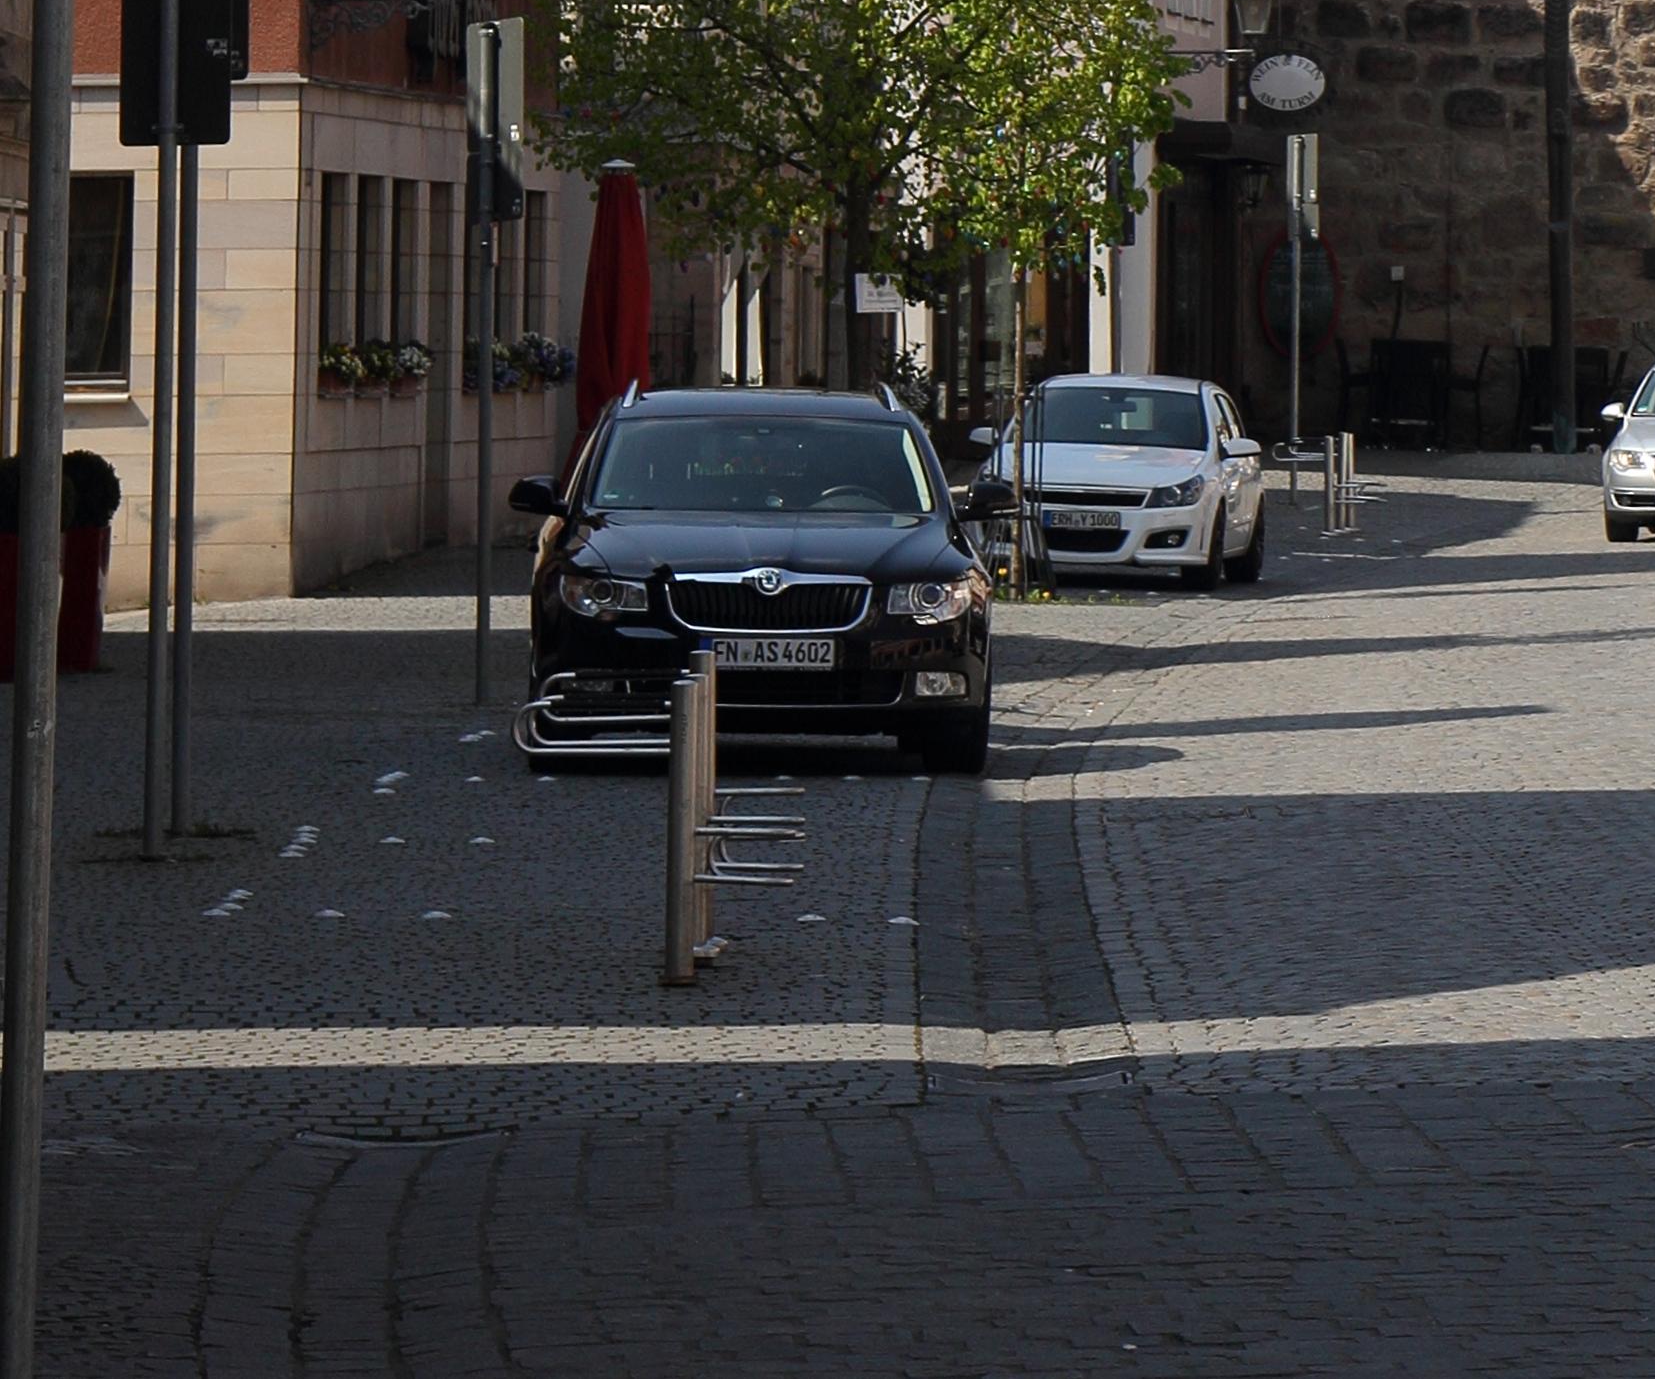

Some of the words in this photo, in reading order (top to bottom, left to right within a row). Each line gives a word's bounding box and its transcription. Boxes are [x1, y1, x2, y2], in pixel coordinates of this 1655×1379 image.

[1089, 513, 1118, 527] 1000
[713, 641, 739, 662] FN
[753, 641, 779, 663] AS
[782, 641, 831, 663] 4602
